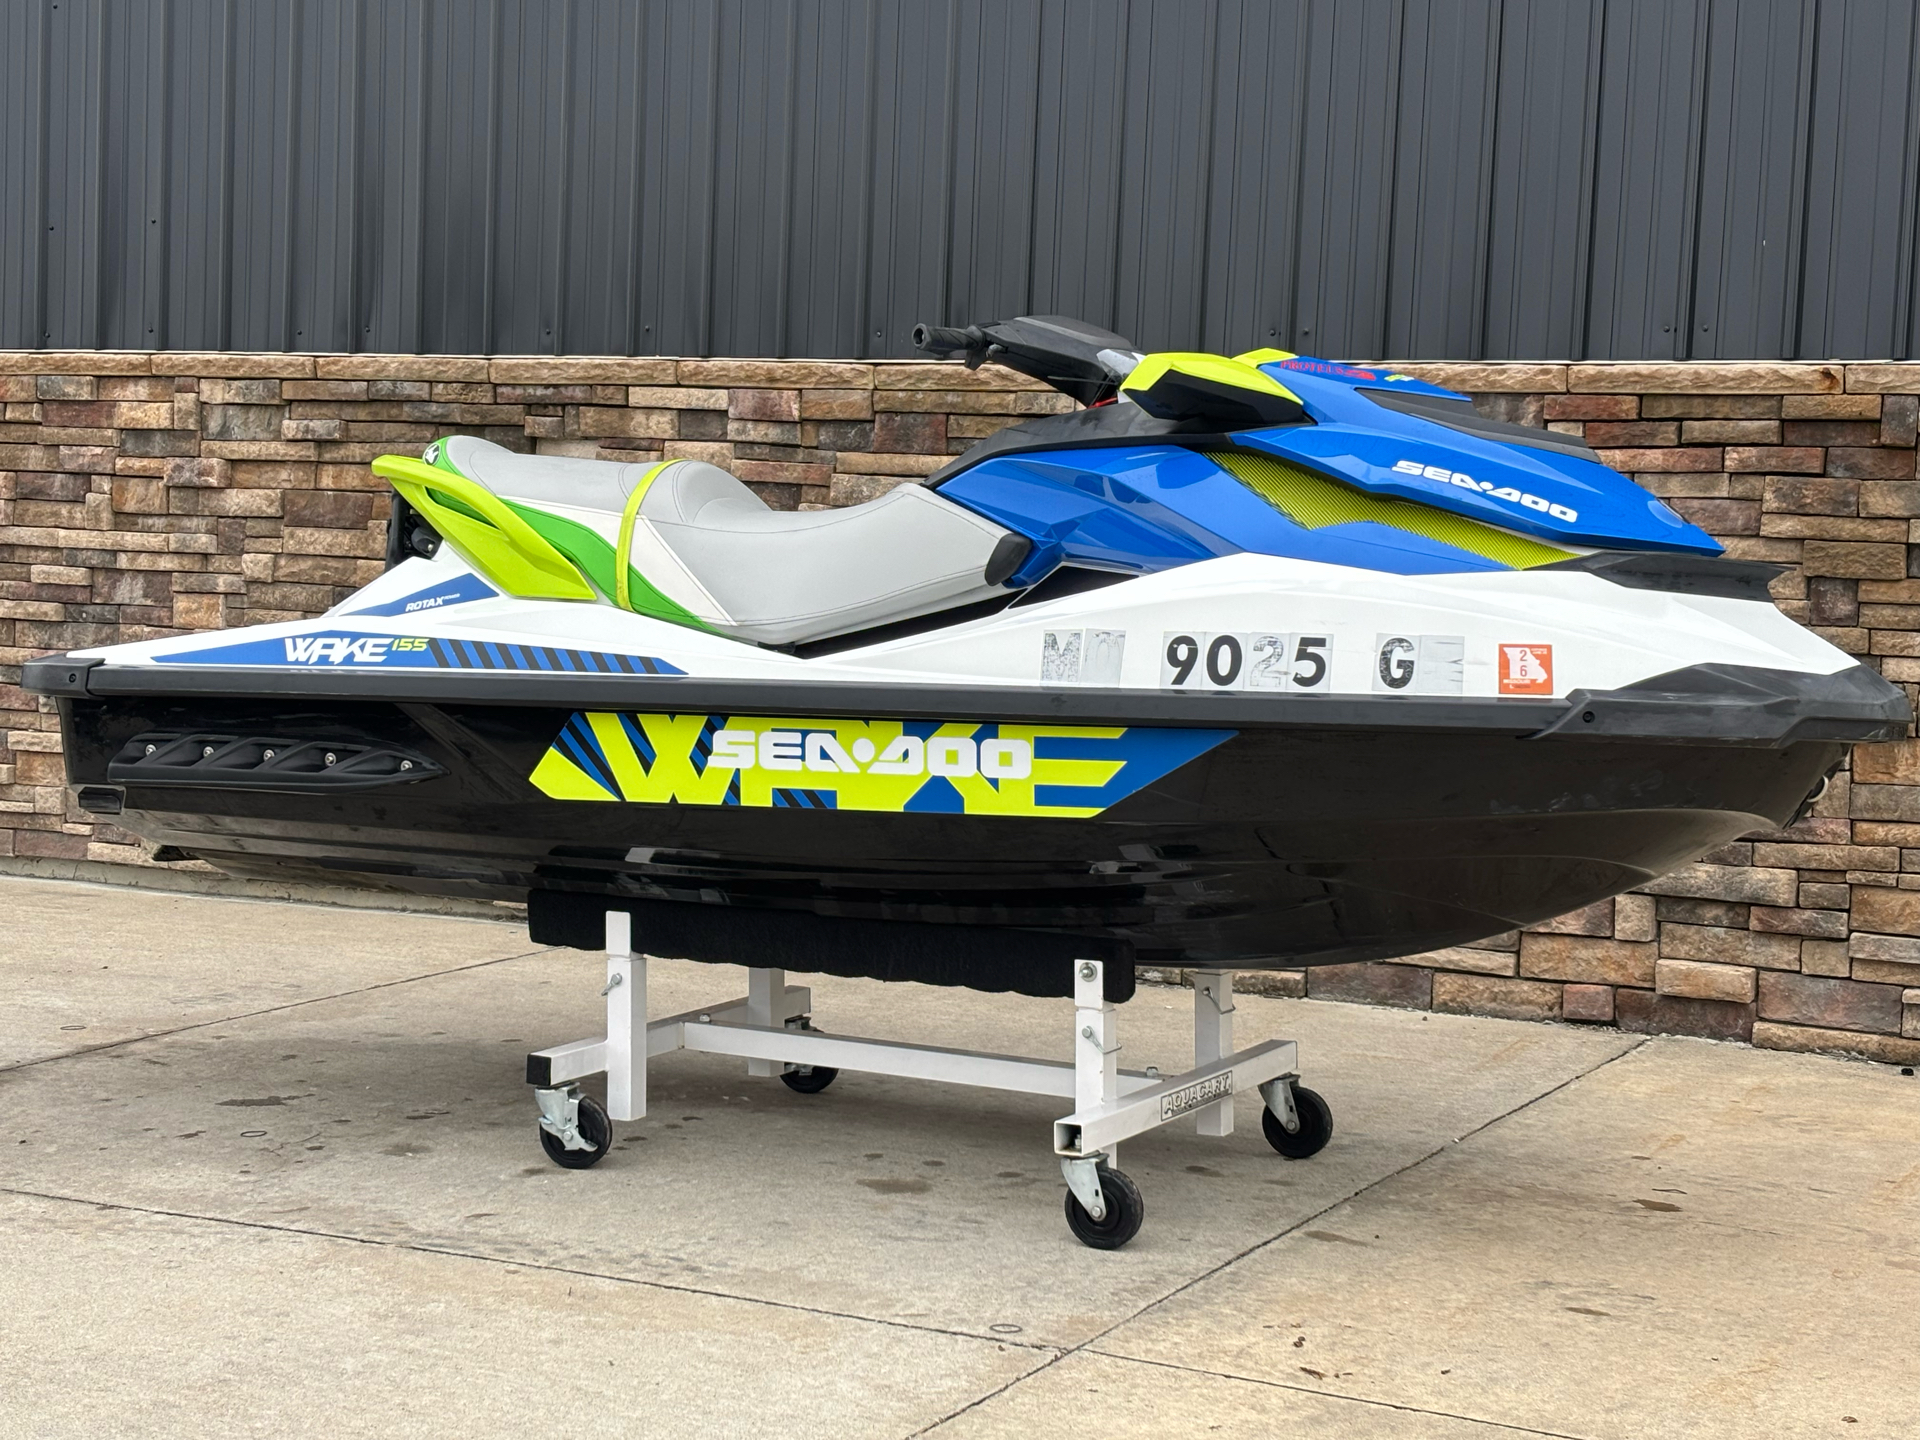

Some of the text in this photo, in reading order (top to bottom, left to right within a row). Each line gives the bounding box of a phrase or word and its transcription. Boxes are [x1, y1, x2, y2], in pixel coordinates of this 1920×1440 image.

[405, 596, 443, 612] ROTAX
[284, 637, 430, 665] WAKE 155
[1519, 649, 1528, 662] 2
[1166, 635, 1327, 687] 9025
[1519, 664, 1528, 677] 6
